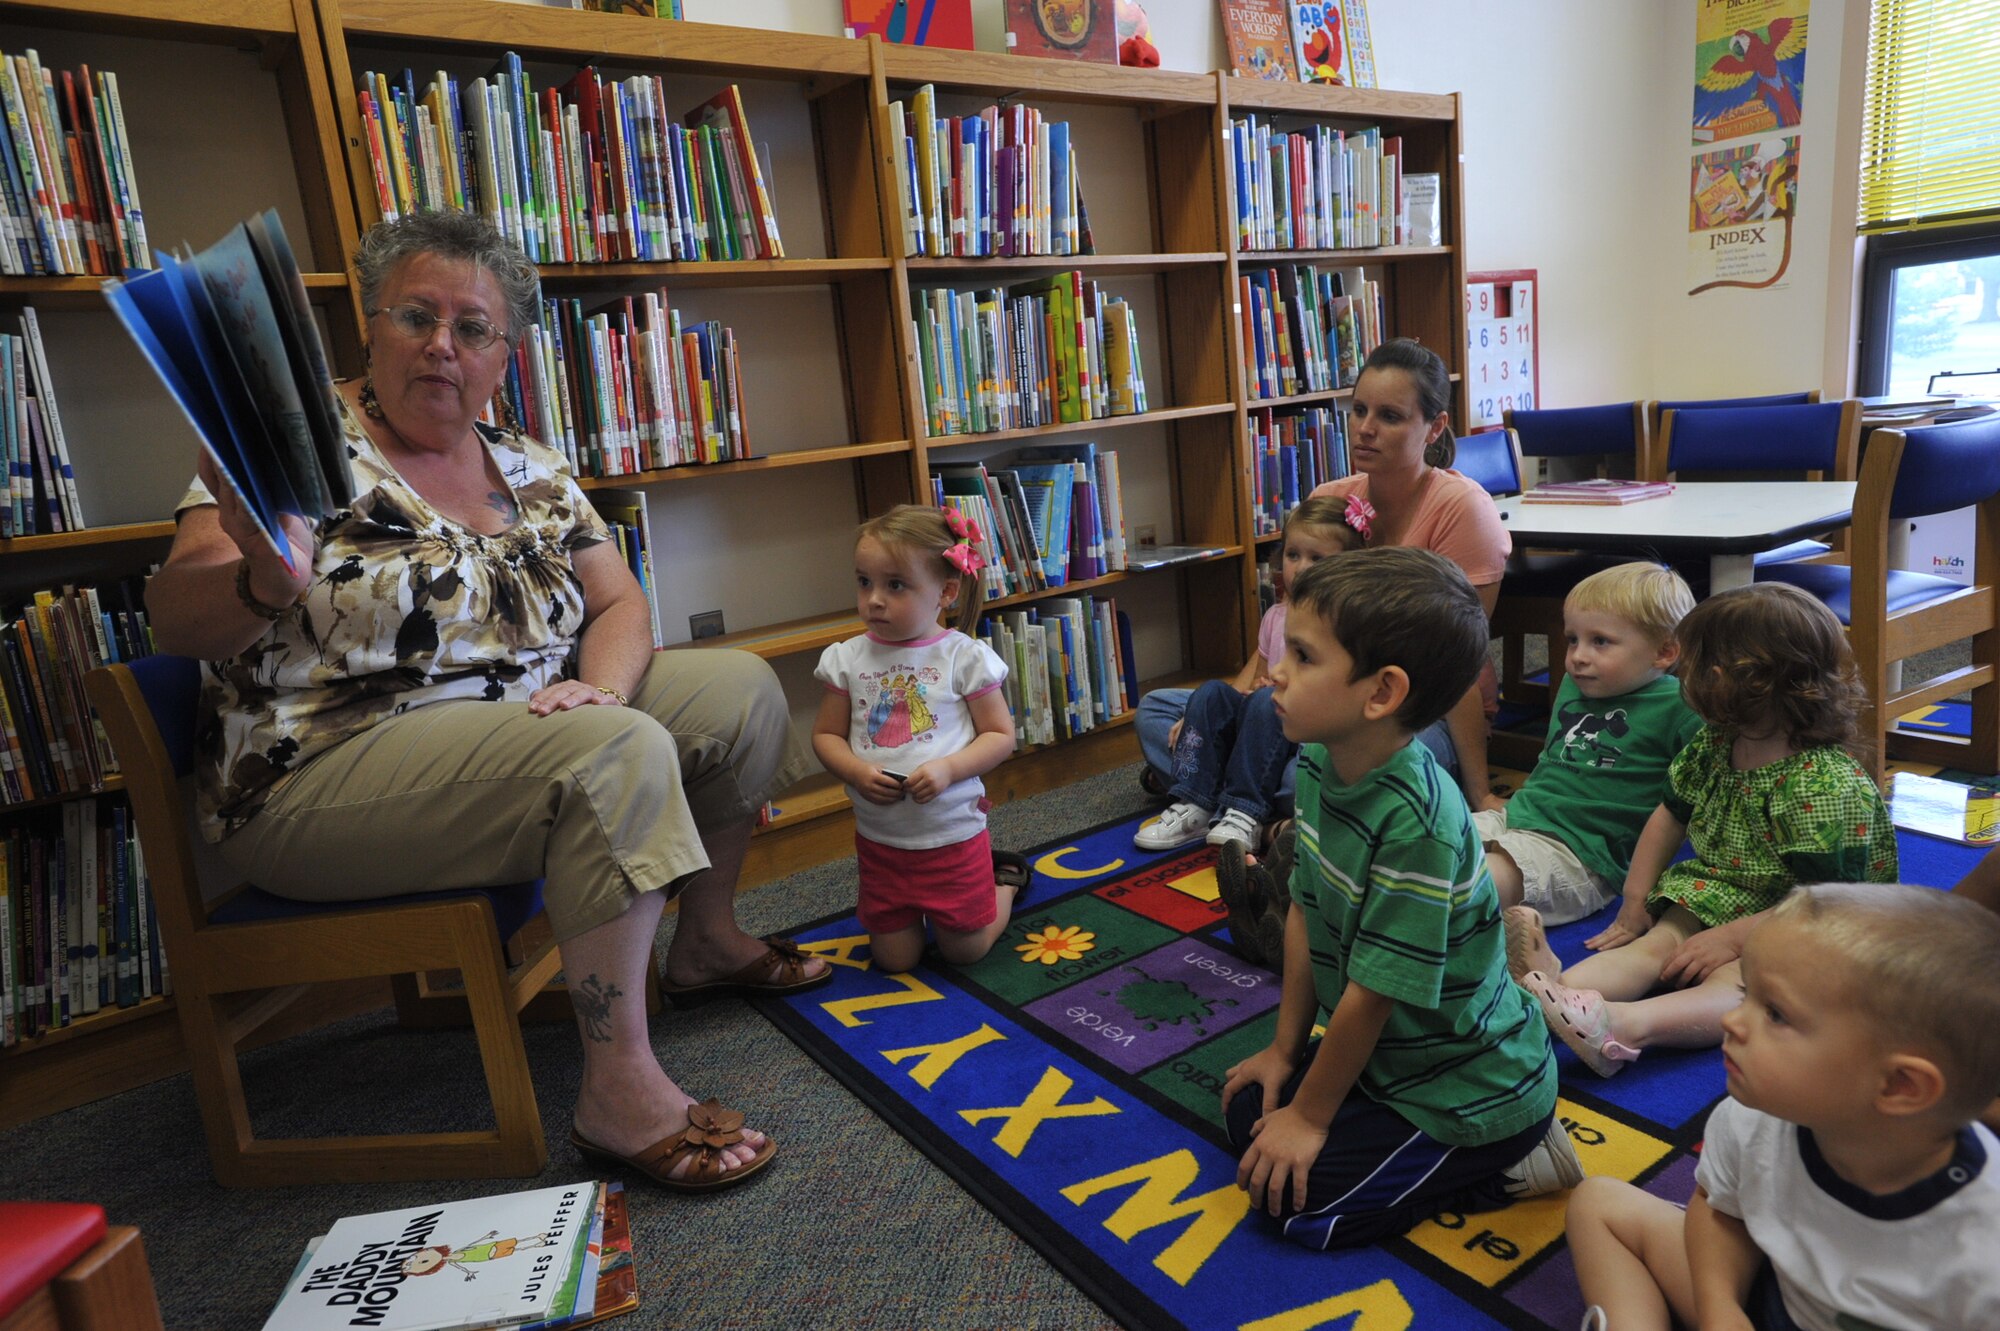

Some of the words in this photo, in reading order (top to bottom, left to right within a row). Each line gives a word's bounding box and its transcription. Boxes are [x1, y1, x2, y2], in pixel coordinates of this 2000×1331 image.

[1230, 8, 1282, 26] EVERYDAY
[1299, 2, 1337, 28] ABC
[1240, 21, 1278, 36] WORDS
[557, 159, 565, 182] FRIENDS
[560, 183, 566, 193] AT
[561, 194, 569, 227] CHRISTMAS
[1709, 228, 1766, 250] INDEX
[1480, 292, 1488, 312] 9
[1519, 289, 1527, 309] 7
[28, 317, 36, 326] Eric
[31, 327, 39, 339] Carle
[1480, 328, 1488, 348] 6
[1500, 326, 1507, 345] 5
[1517, 323, 1530, 344] 11
[1481, 363, 1487, 383] 1
[1501, 361, 1509, 381] 3
[1520, 358, 1528, 378] 4
[1478, 398, 1494, 419] 12
[1498, 395, 1512, 415] 13
[1518, 392, 1532, 412] 10
[897, 663, 915, 673] Time
[1033, 846, 1125, 880] C
[117, 871, 124, 881] UP
[23, 896, 30, 907] ON
[1106, 885, 1132, 899] el
[23, 907, 31, 921] THE
[24, 922, 32, 947] TITANIC
[59, 932, 66, 941] OF
[797, 934, 873, 972] A
[1044, 946, 1127, 982] flower
[1183, 952, 1263, 989] green
[818, 972, 948, 1028] Z
[1066, 1006, 1137, 1048] verde
[880, 1021, 1009, 1091] Y
[957, 1065, 1123, 1159] X
[1059, 1148, 1252, 1287] W
[521, 1254, 553, 1302] JULES
[546, 1190, 579, 1247] FEIFFER
[301, 1261, 348, 1293] THE
[326, 1241, 393, 1307] DADDY
[349, 1210, 445, 1326] MOUNTAIN
